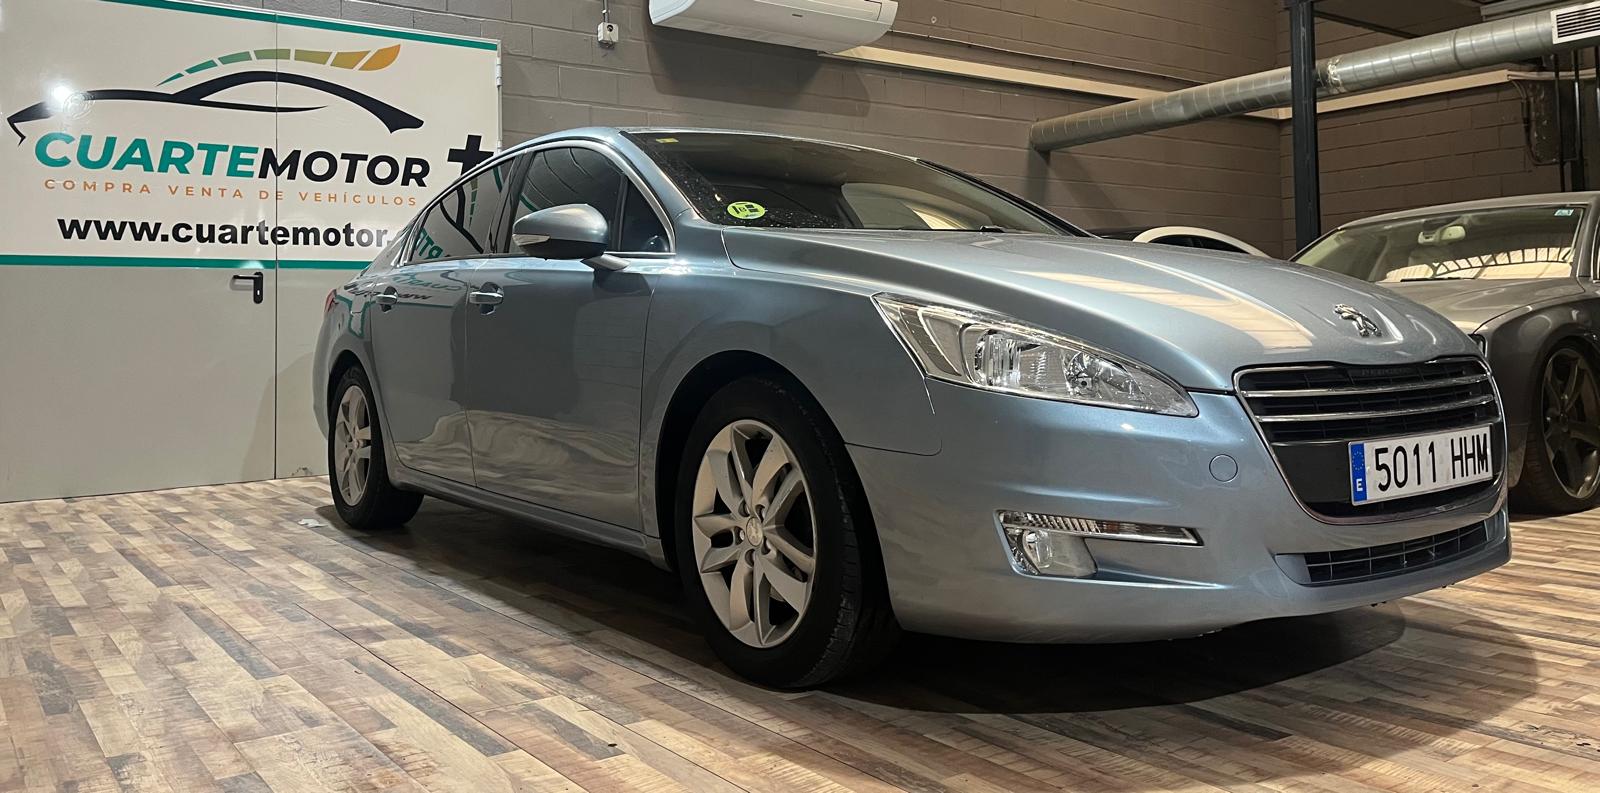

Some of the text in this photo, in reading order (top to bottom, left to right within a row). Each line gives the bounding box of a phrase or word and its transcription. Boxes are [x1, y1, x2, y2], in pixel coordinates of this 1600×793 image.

[35, 132, 430, 187] CUARTEMOTOR
[45, 180, 416, 206] COMPRA VENTA DE VEHÍCULOS
[1375, 433, 1489, 492] 5011 HHM
[1355, 478, 1363, 492] E
